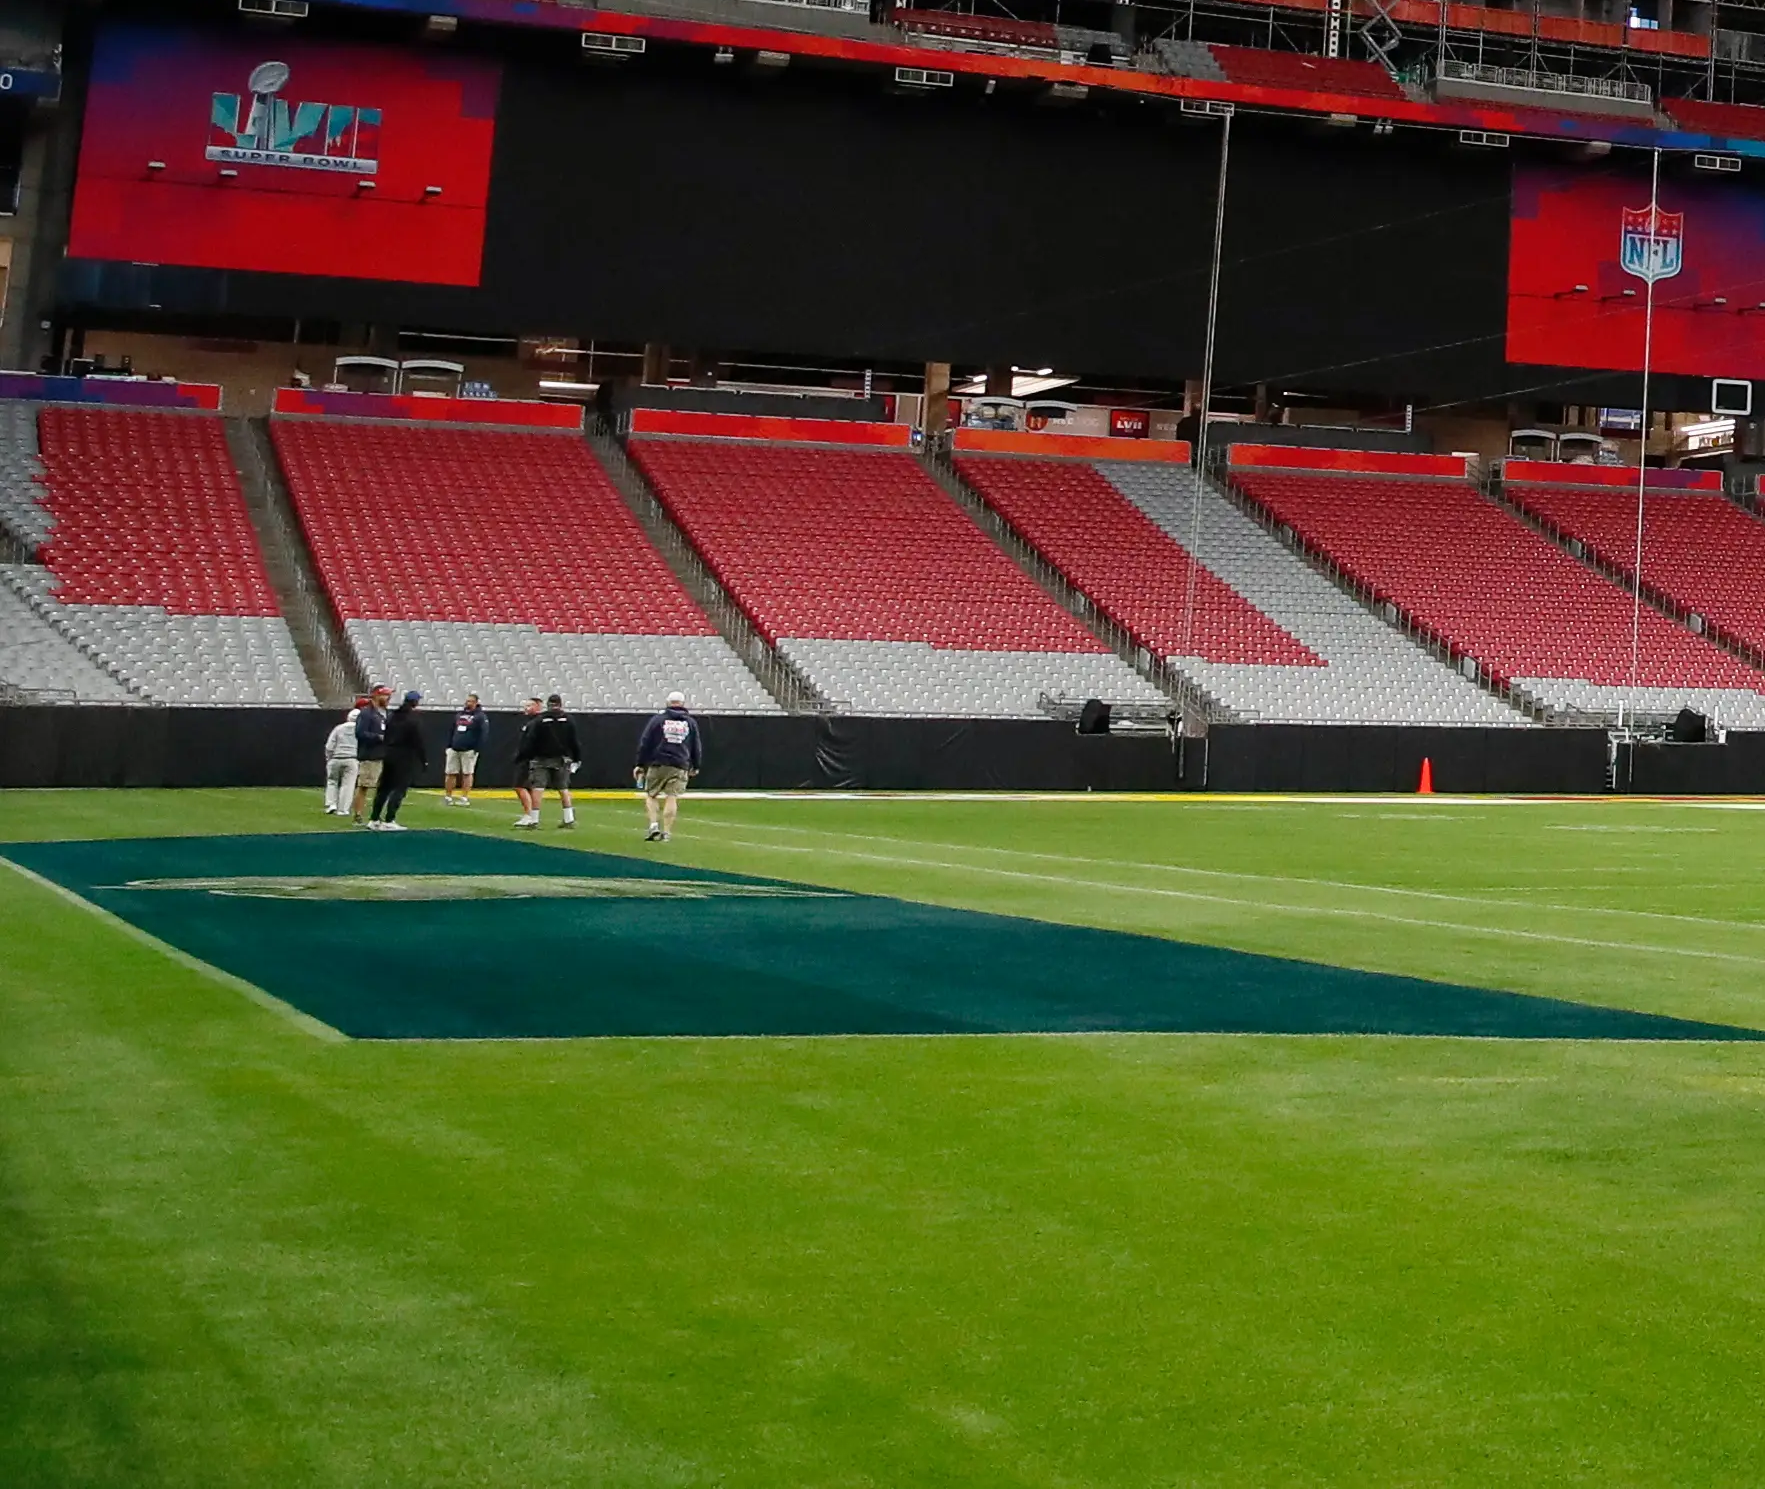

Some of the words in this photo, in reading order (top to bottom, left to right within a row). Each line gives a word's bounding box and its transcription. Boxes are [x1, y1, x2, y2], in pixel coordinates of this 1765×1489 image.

[207, 92, 383, 159] LVII
[220, 149, 291, 163] SUPER
[303, 156, 363, 170] BOWL
[1625, 234, 1678, 271] NFL
